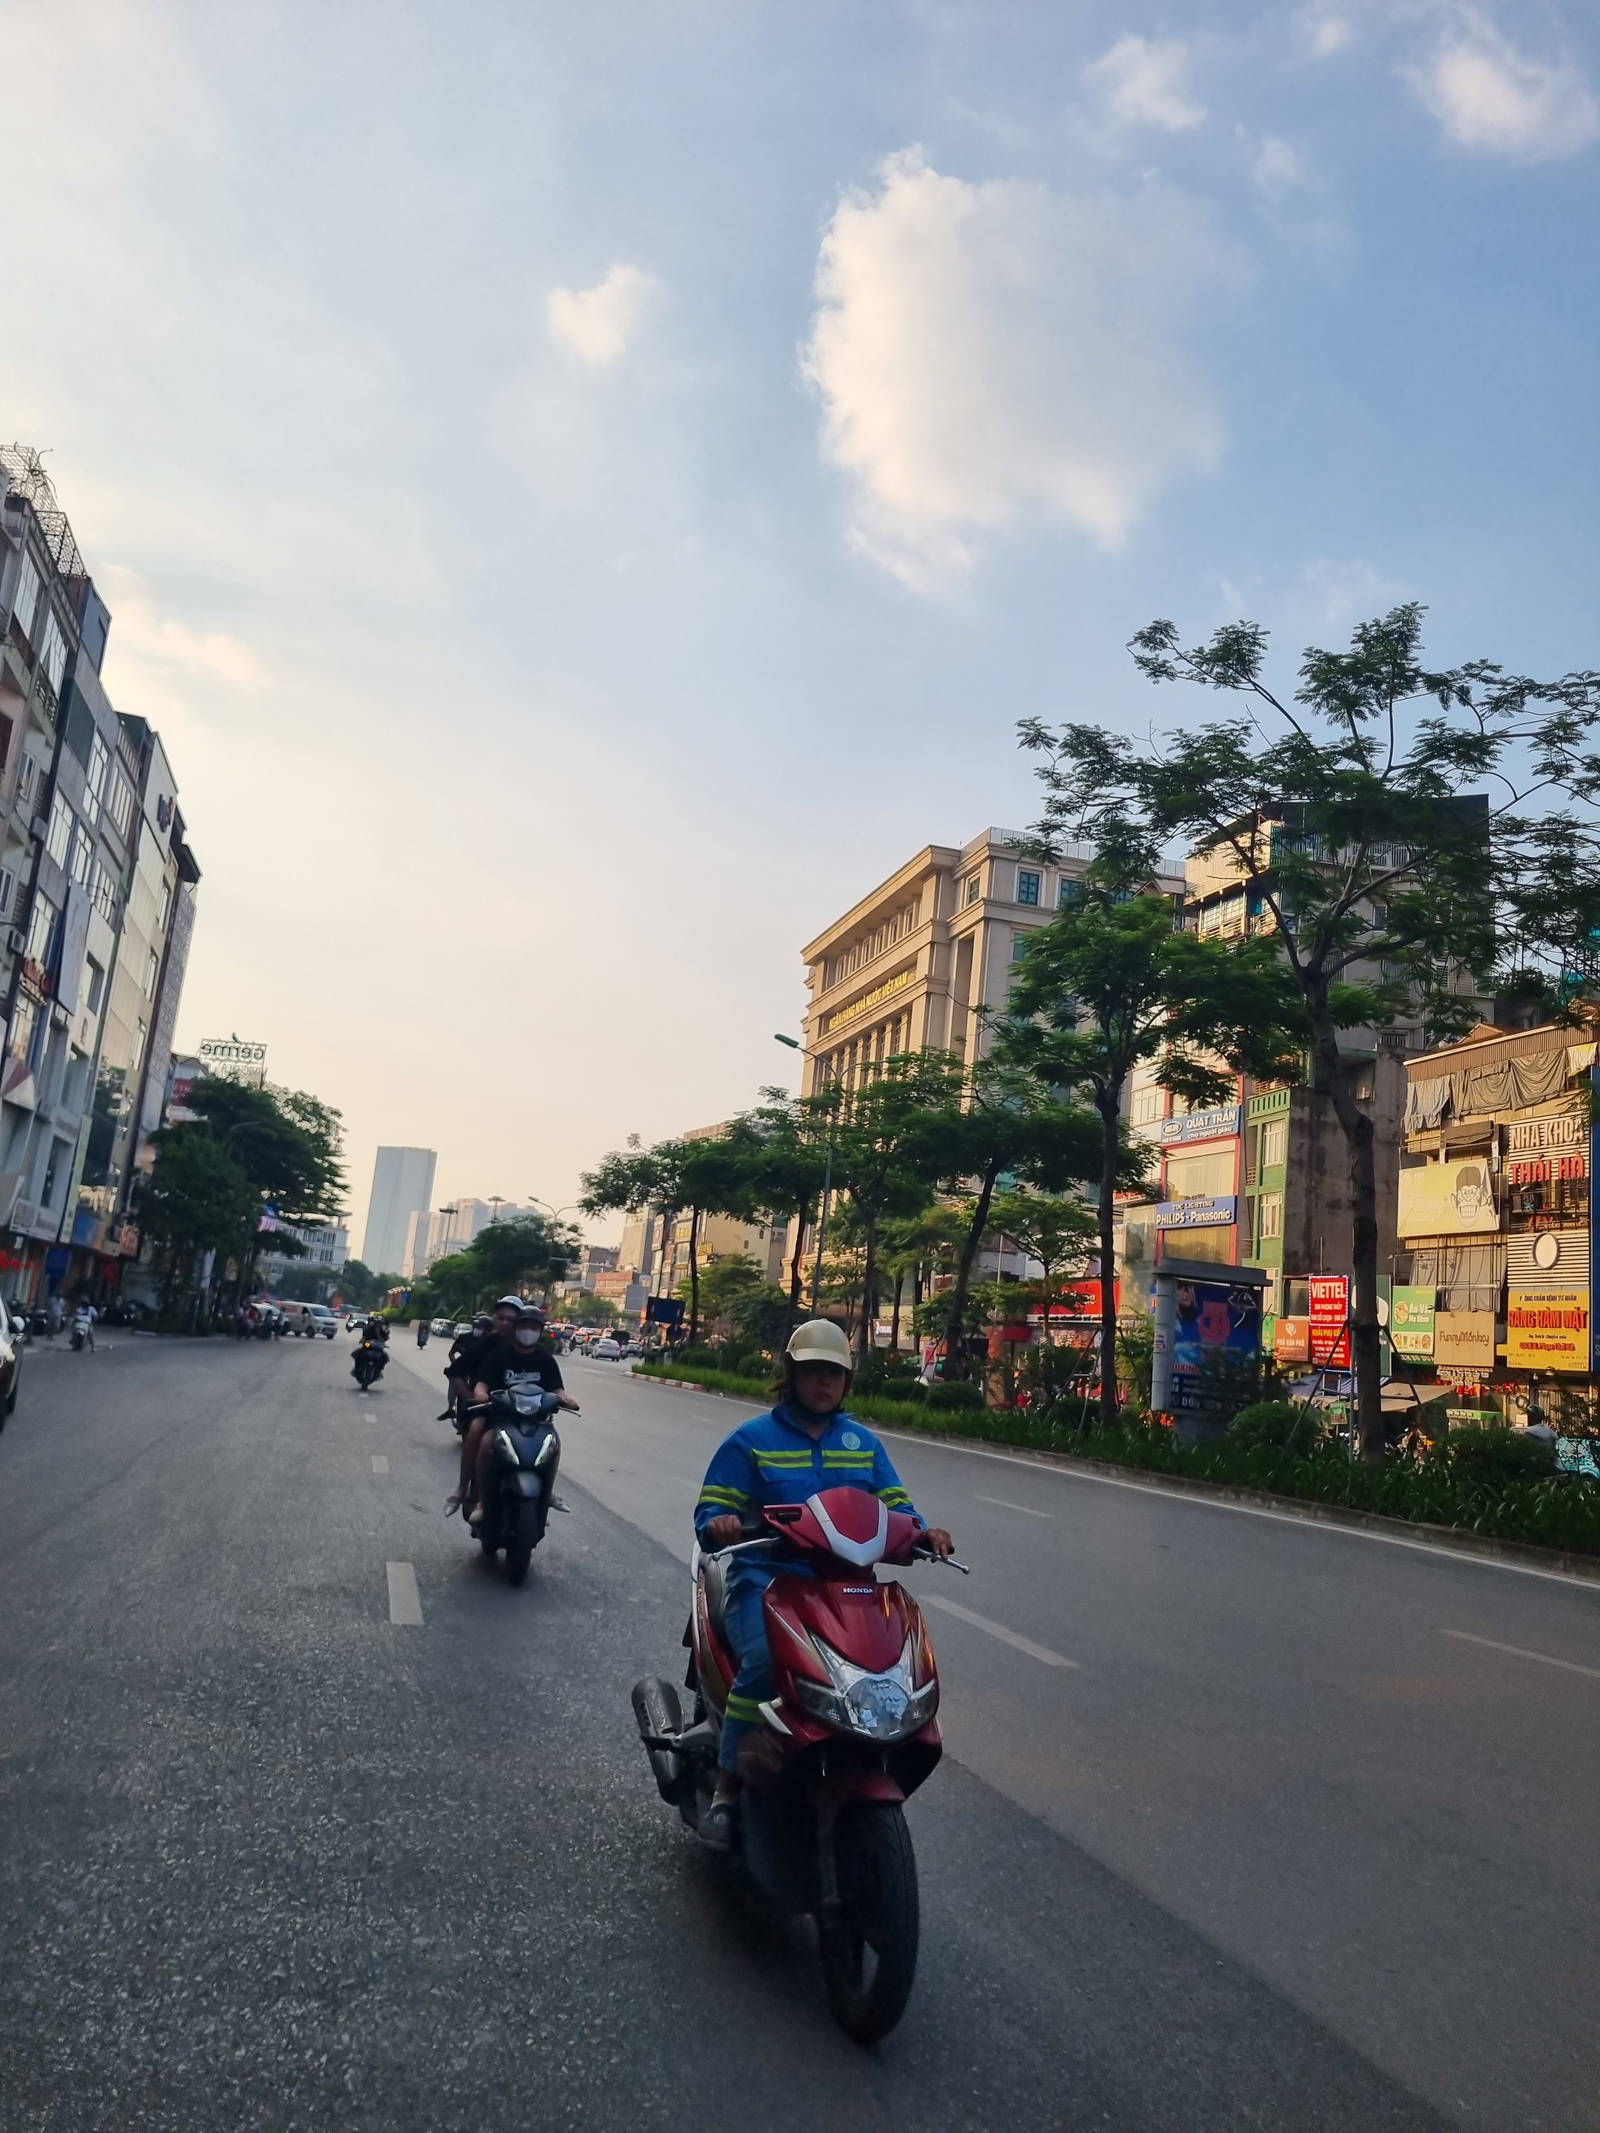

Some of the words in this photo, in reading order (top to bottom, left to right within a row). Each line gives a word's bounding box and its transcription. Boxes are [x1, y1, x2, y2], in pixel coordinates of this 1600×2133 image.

[1511, 1125, 1541, 1150] NHA
[1510, 1153, 1552, 1185] THÁI
[1558, 1149, 1585, 1180] HÀ
[1156, 1211, 1186, 1226] PHILIPS
[1190, 1208, 1232, 1223] Panasonic
[1311, 1281, 1346, 1299] VIETTEL
[1563, 1306, 1588, 1332] MẶT
